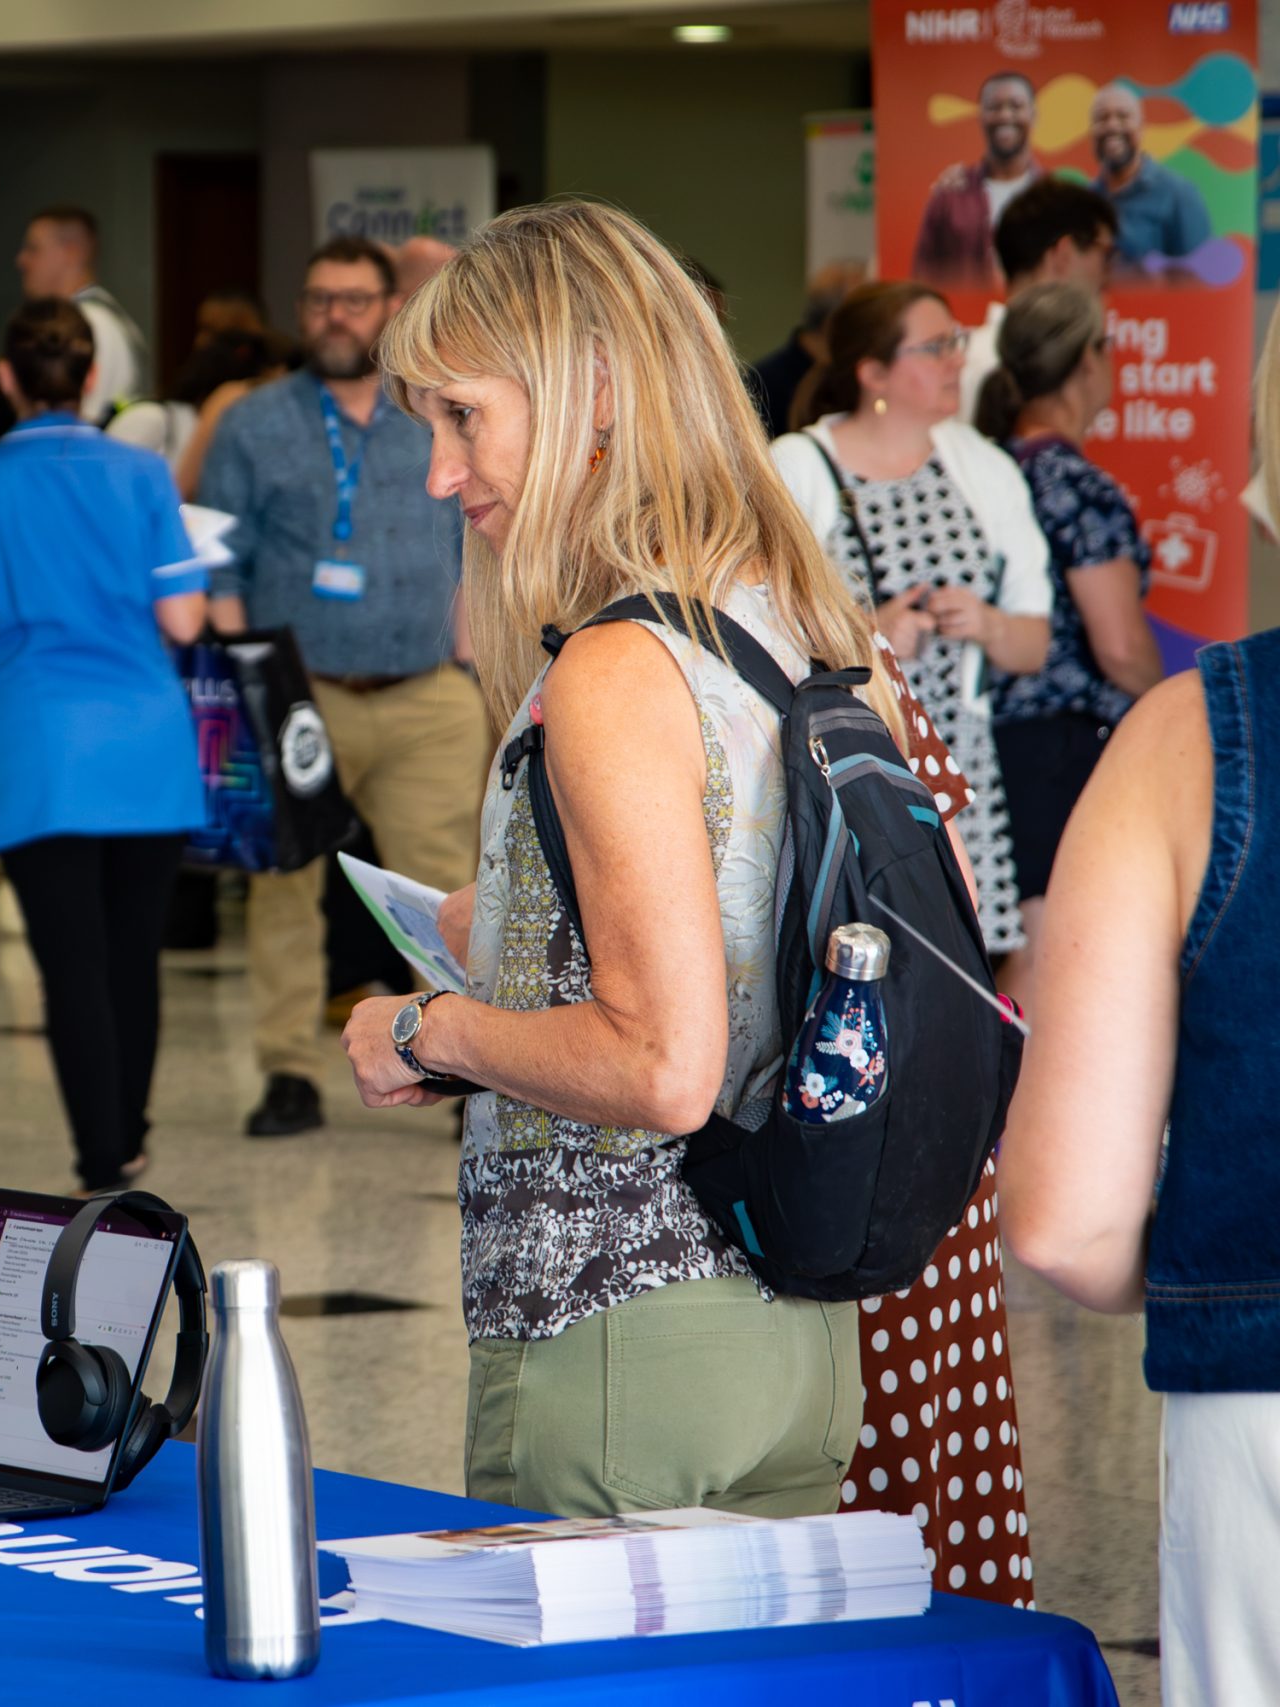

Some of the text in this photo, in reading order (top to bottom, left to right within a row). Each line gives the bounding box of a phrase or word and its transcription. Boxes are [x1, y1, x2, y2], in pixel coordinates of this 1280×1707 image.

[906, 9, 981, 43] NIHR
[1170, 2, 1227, 30] NHS
[1106, 309, 1167, 360] ing
[1120, 356, 1217, 395] start
[1123, 398, 1195, 442] like
[184, 678, 237, 703] LUS
[51, 1292, 59, 1327] SONY
